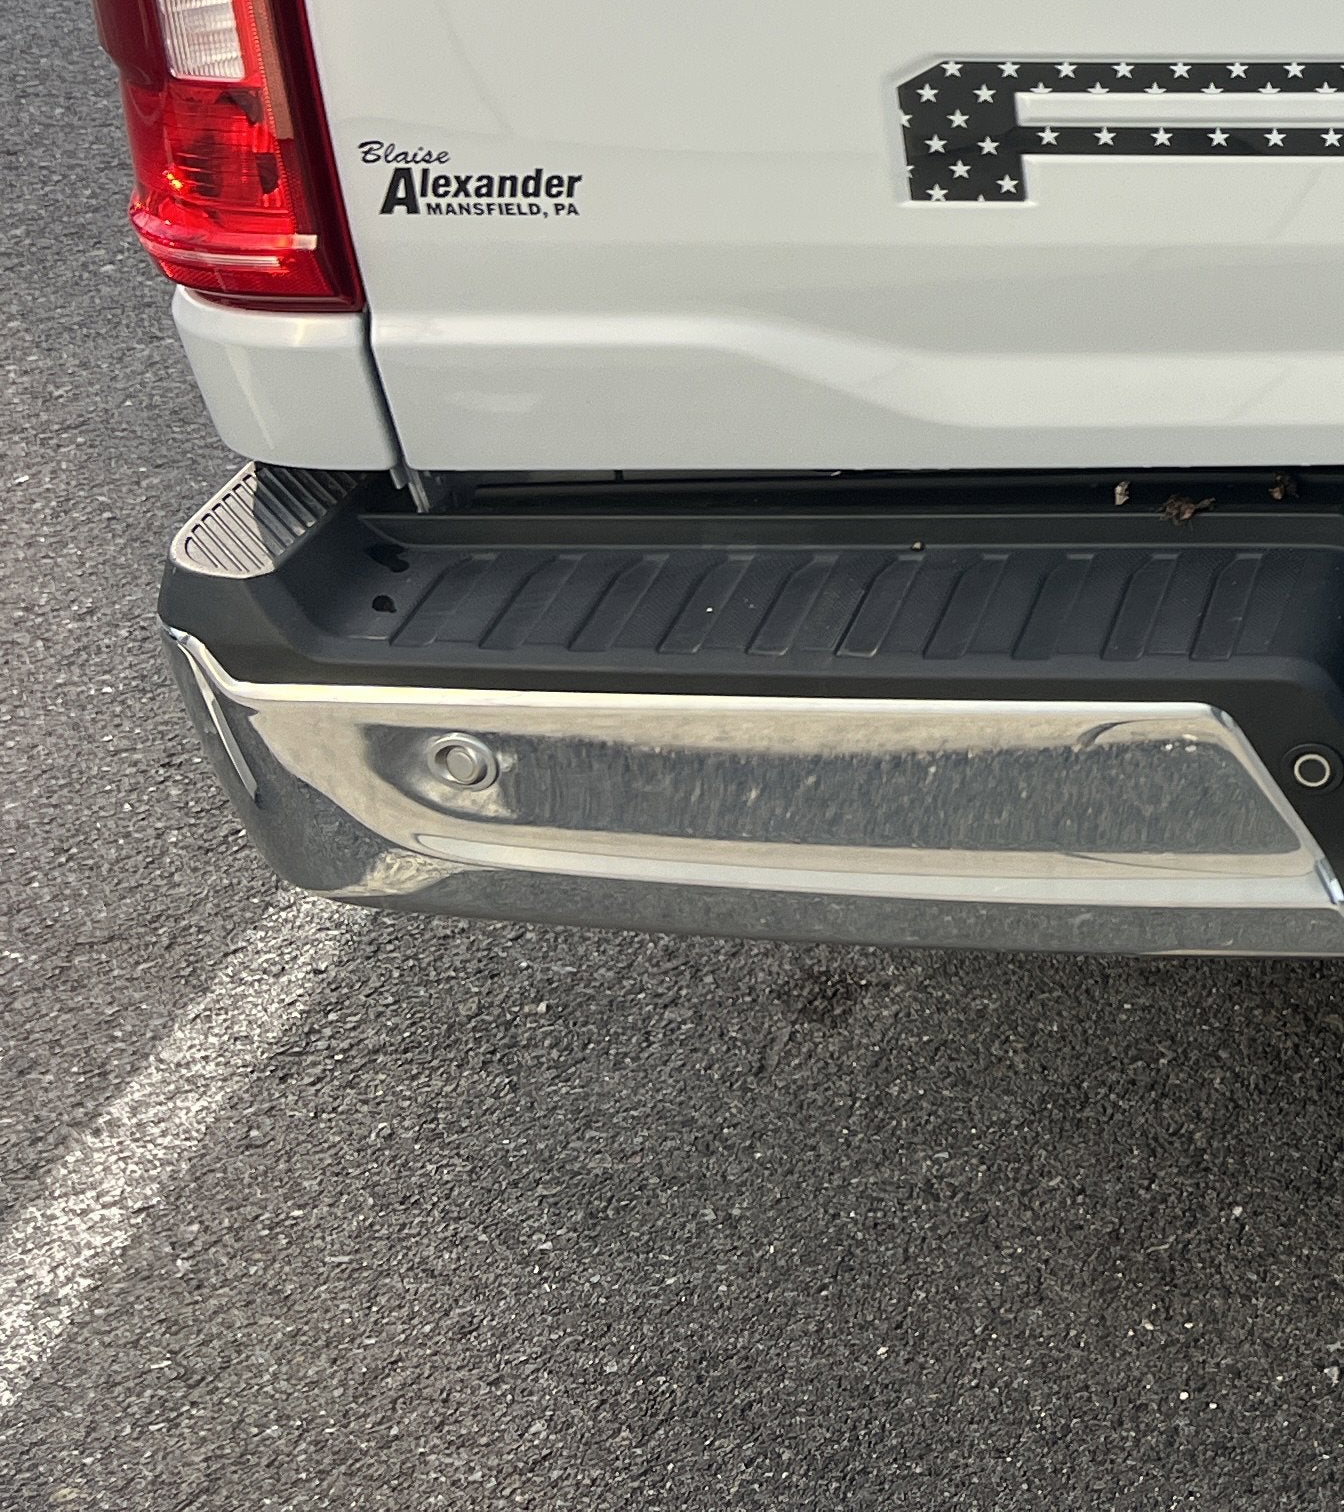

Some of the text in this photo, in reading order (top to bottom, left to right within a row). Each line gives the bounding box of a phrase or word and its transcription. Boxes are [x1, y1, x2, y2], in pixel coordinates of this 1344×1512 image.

[358, 140, 451, 164] Blaise
[379, 167, 583, 215] Alexander
[426, 202, 581, 219] MANSFIELD, PA
